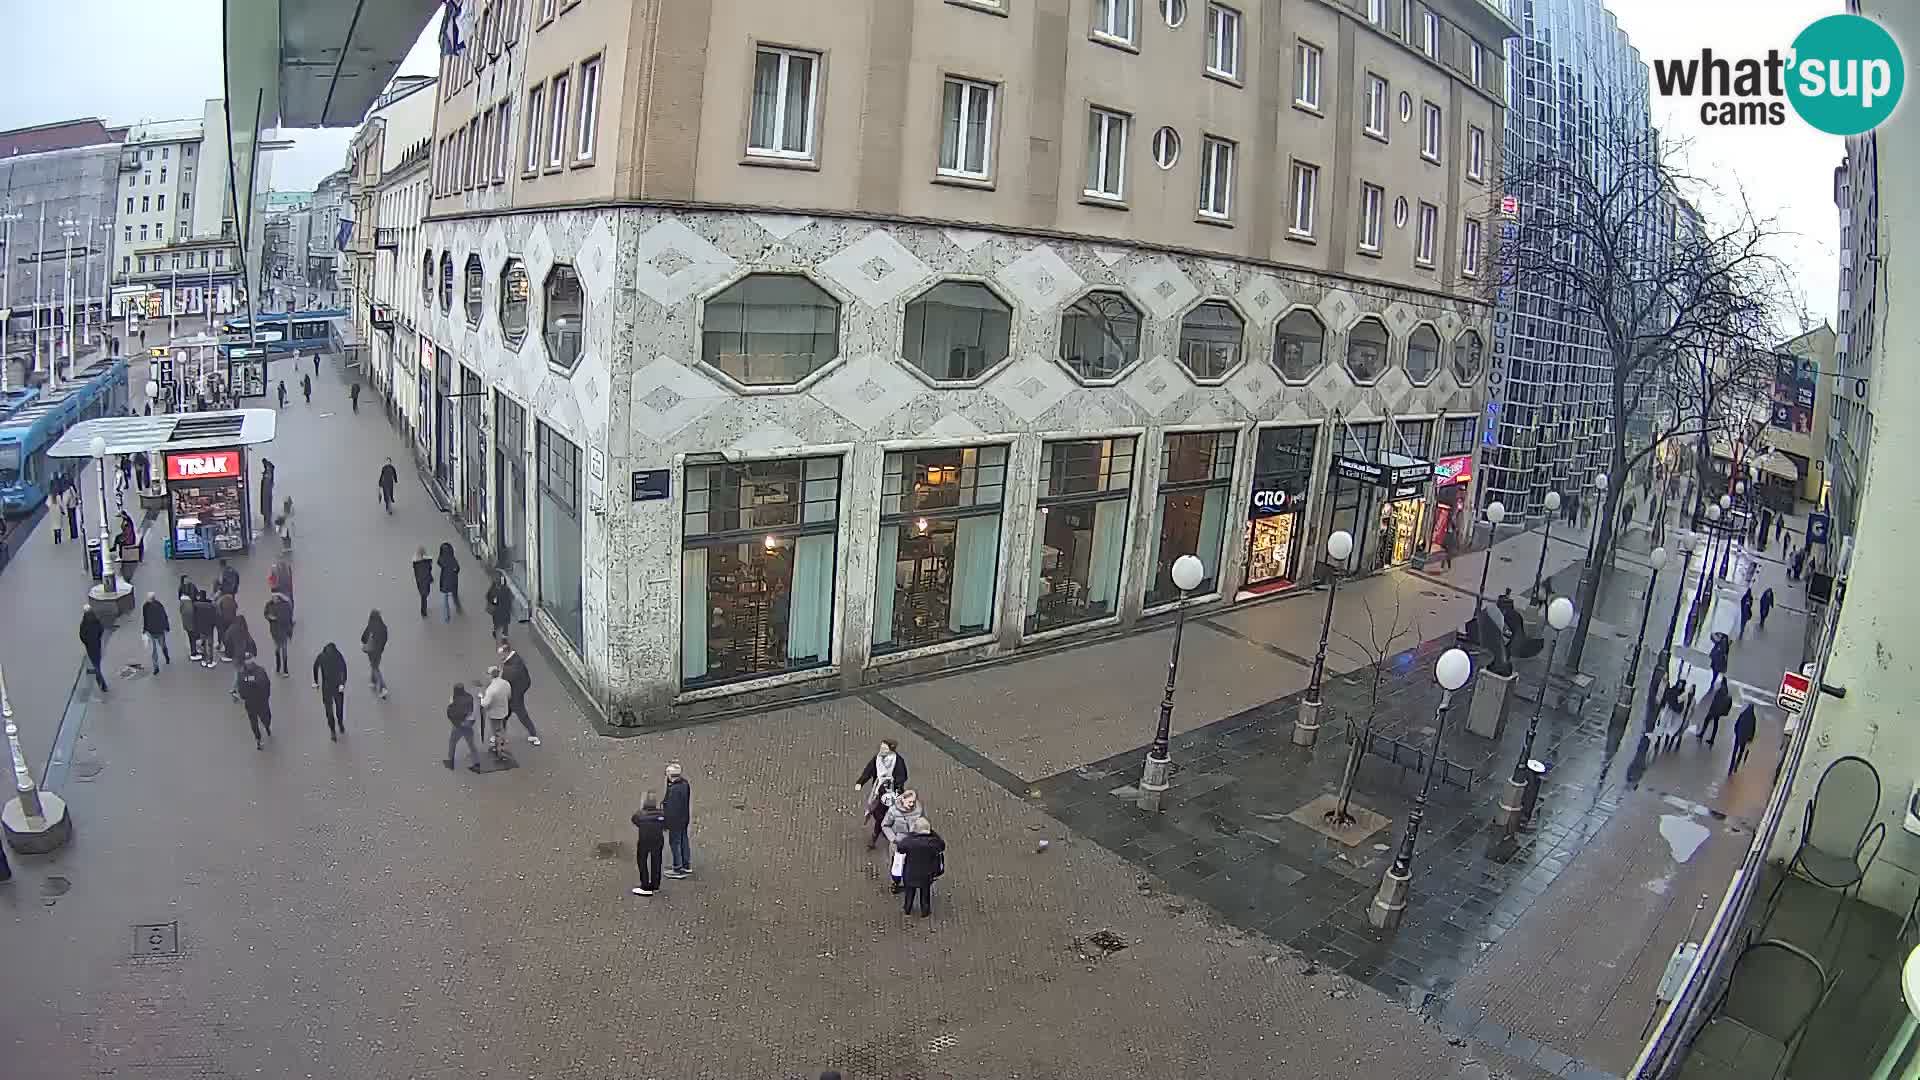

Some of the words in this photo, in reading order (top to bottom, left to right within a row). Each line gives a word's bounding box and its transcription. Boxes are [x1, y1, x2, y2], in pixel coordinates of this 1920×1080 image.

[1483, 311, 1508, 446] DUBROVNIK
[177, 456, 228, 475] TISAK
[1254, 490, 1286, 506] CRO
